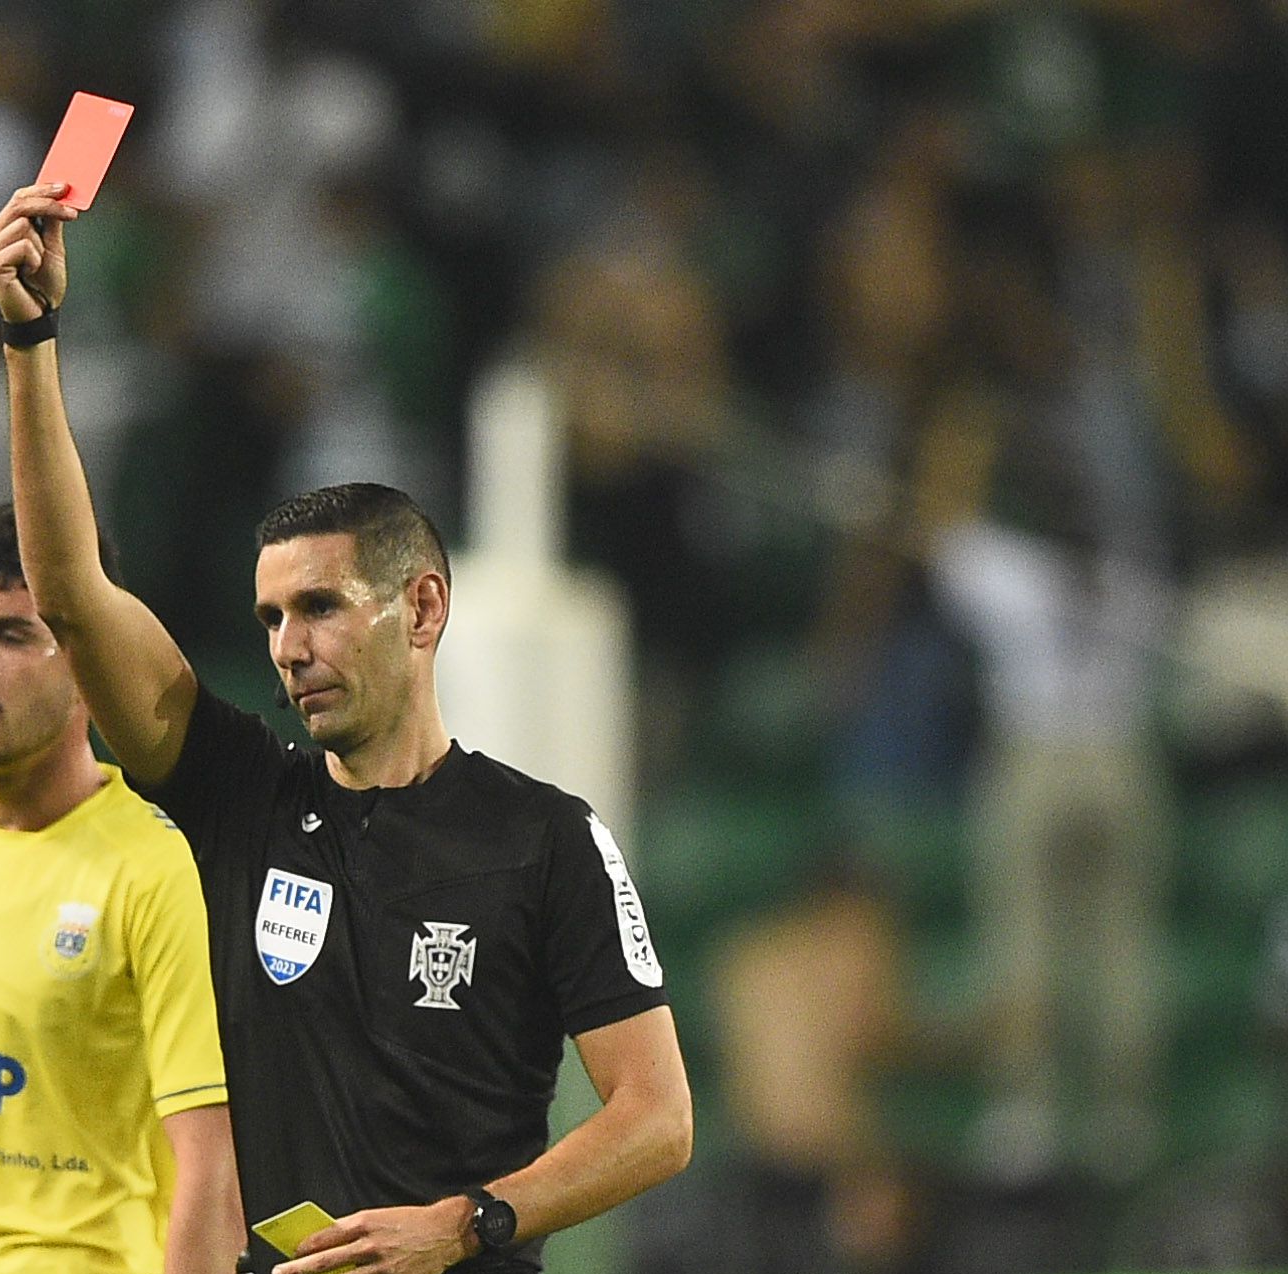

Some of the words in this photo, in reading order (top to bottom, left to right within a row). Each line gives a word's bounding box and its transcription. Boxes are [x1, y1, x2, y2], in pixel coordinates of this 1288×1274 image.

[269, 878, 322, 915] FIFA
[262, 919, 318, 946] REFEREE
[269, 957, 296, 976] 2023
